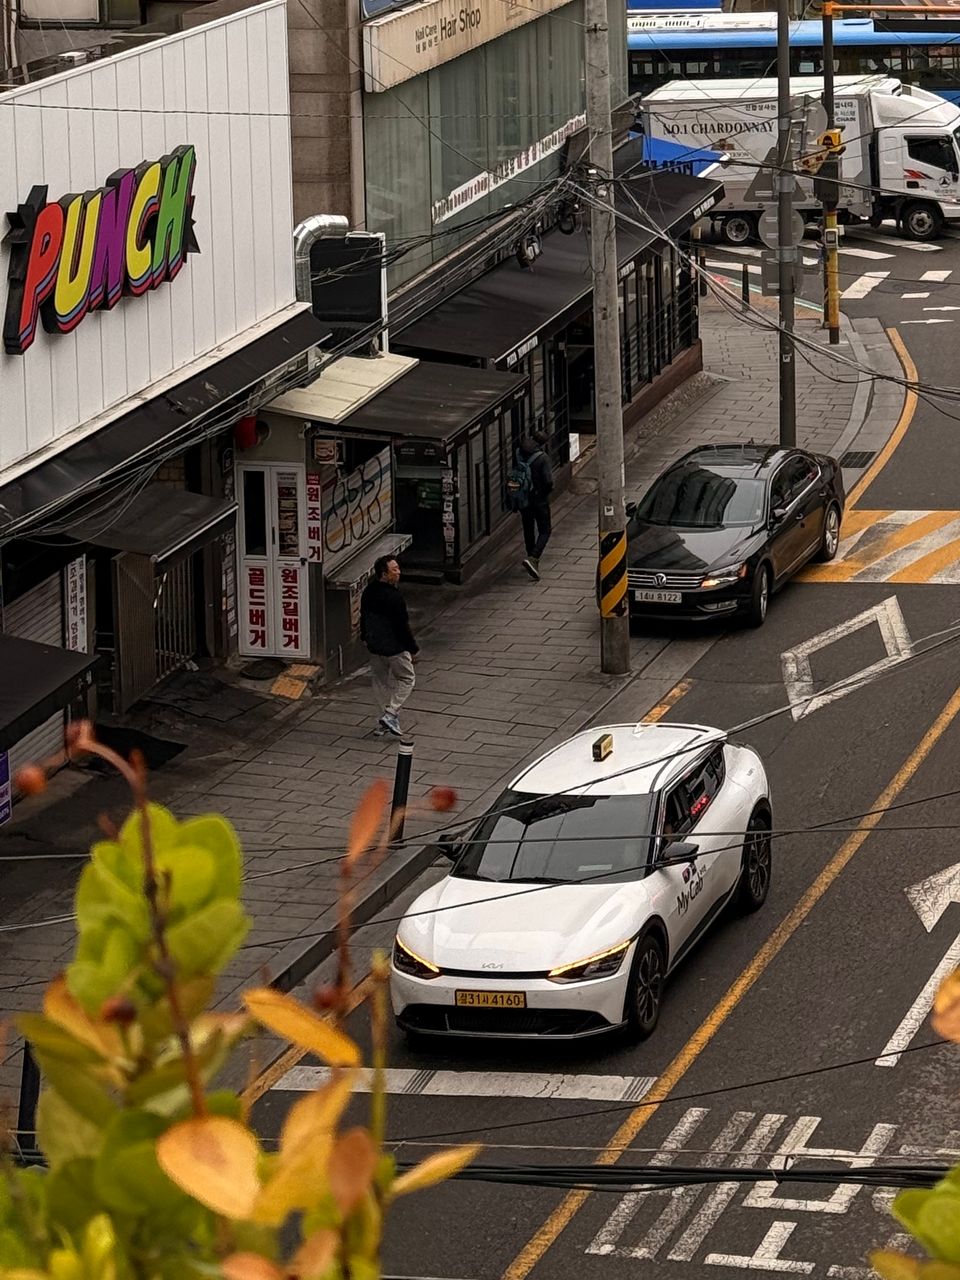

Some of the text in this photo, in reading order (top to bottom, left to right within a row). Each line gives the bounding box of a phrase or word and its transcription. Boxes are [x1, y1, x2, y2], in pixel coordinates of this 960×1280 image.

[439, 8, 482, 42] Hair Shop
[662, 121, 775, 136] NO.1 CHARDONNAY
[18, 144, 198, 352] PUNCH
[306, 486, 321, 562] 원조버거
[248, 567, 300, 650] 골드버거 원조길버거
[657, 593, 678, 602] 8122
[491, 994, 521, 1006] 4160
